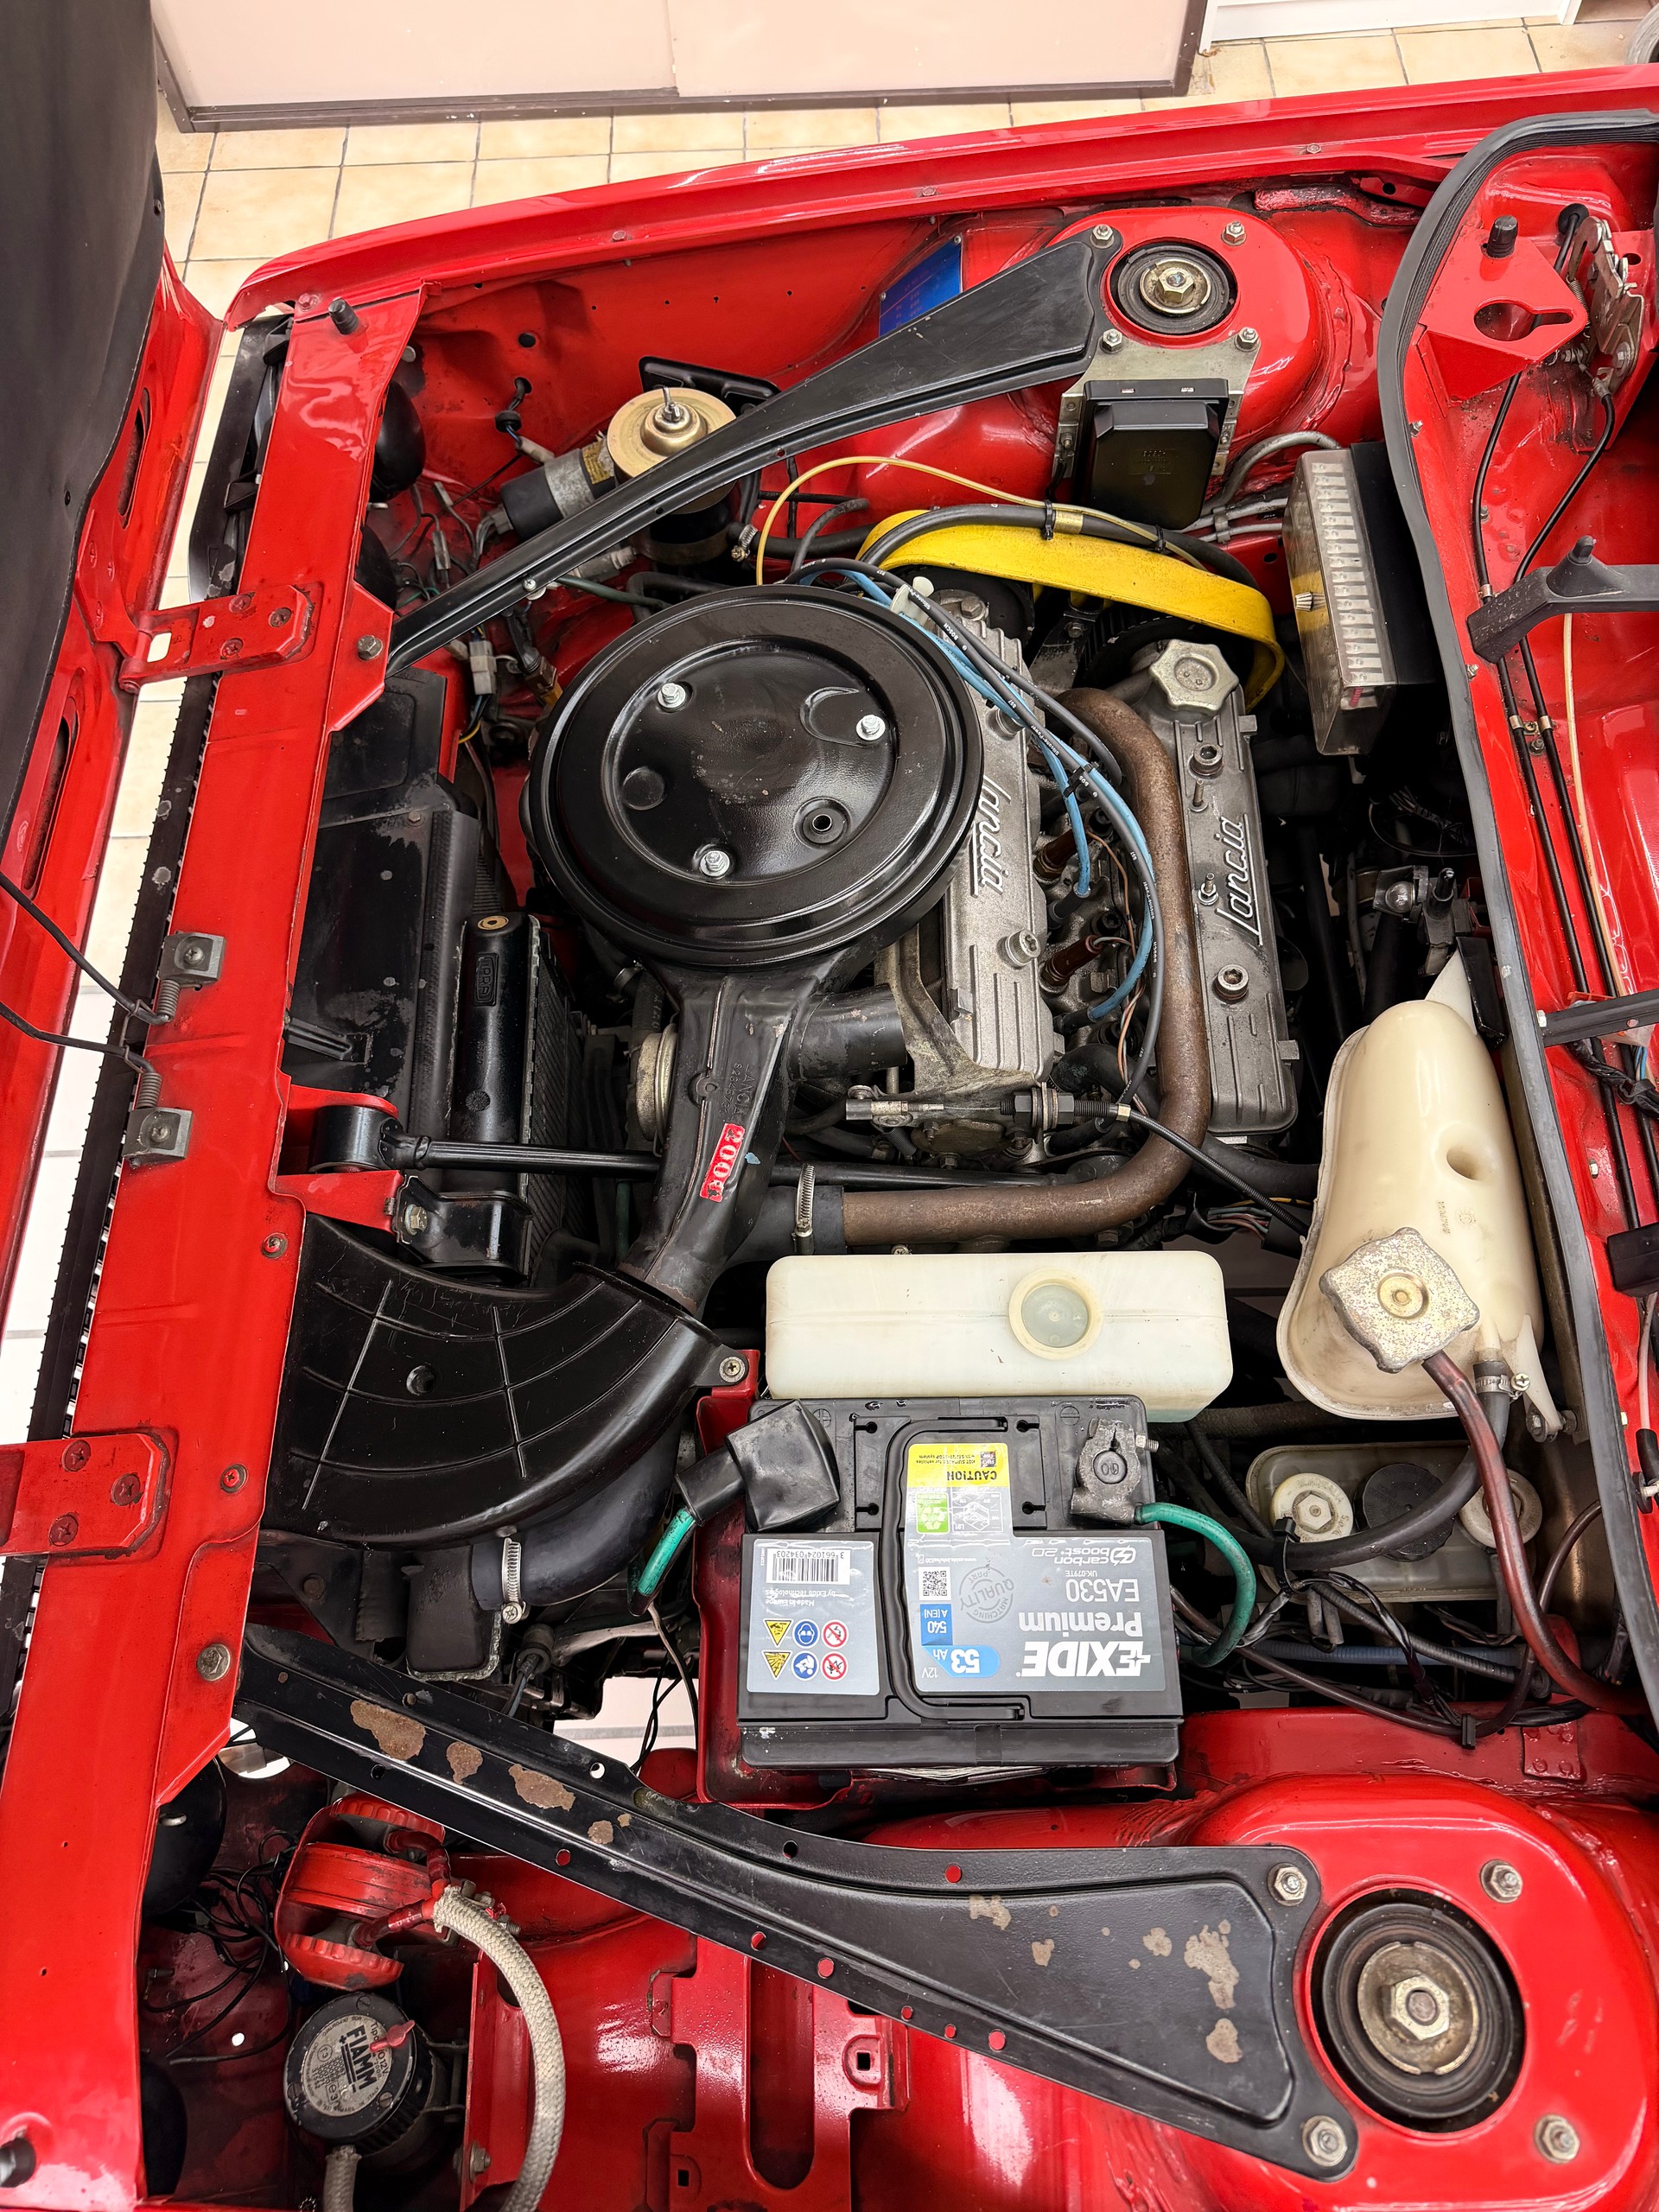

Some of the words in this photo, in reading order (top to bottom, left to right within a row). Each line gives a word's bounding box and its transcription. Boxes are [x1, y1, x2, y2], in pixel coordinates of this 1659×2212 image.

[943, 622, 959, 641] BOSCH
[1031, 725, 1060, 756] Silicone-Power
[1215, 813, 1264, 947] Lancia
[947, 1471, 997, 1481] CAUTION
[1054, 1557, 1109, 1567] carbon
[1065, 1548, 1109, 1557] boost
[968, 1571, 988, 1583] PART
[959, 1578, 1014, 1611] QUALITY
[1065, 1578, 1140, 1602] EA530
[941, 1609, 947, 1618] A
[973, 1597, 1008, 1619] MATCHING
[927, 1621, 947, 1633] 540
[1018, 1611, 1143, 1637] Premium
[933, 1649, 948, 1660] Ah
[950, 1649, 980, 1674] 53
[1020, 1640, 1151, 1677] EXIDE
[921, 1668, 938, 1678] 12V
[346, 2024, 378, 2090] FIAMM
